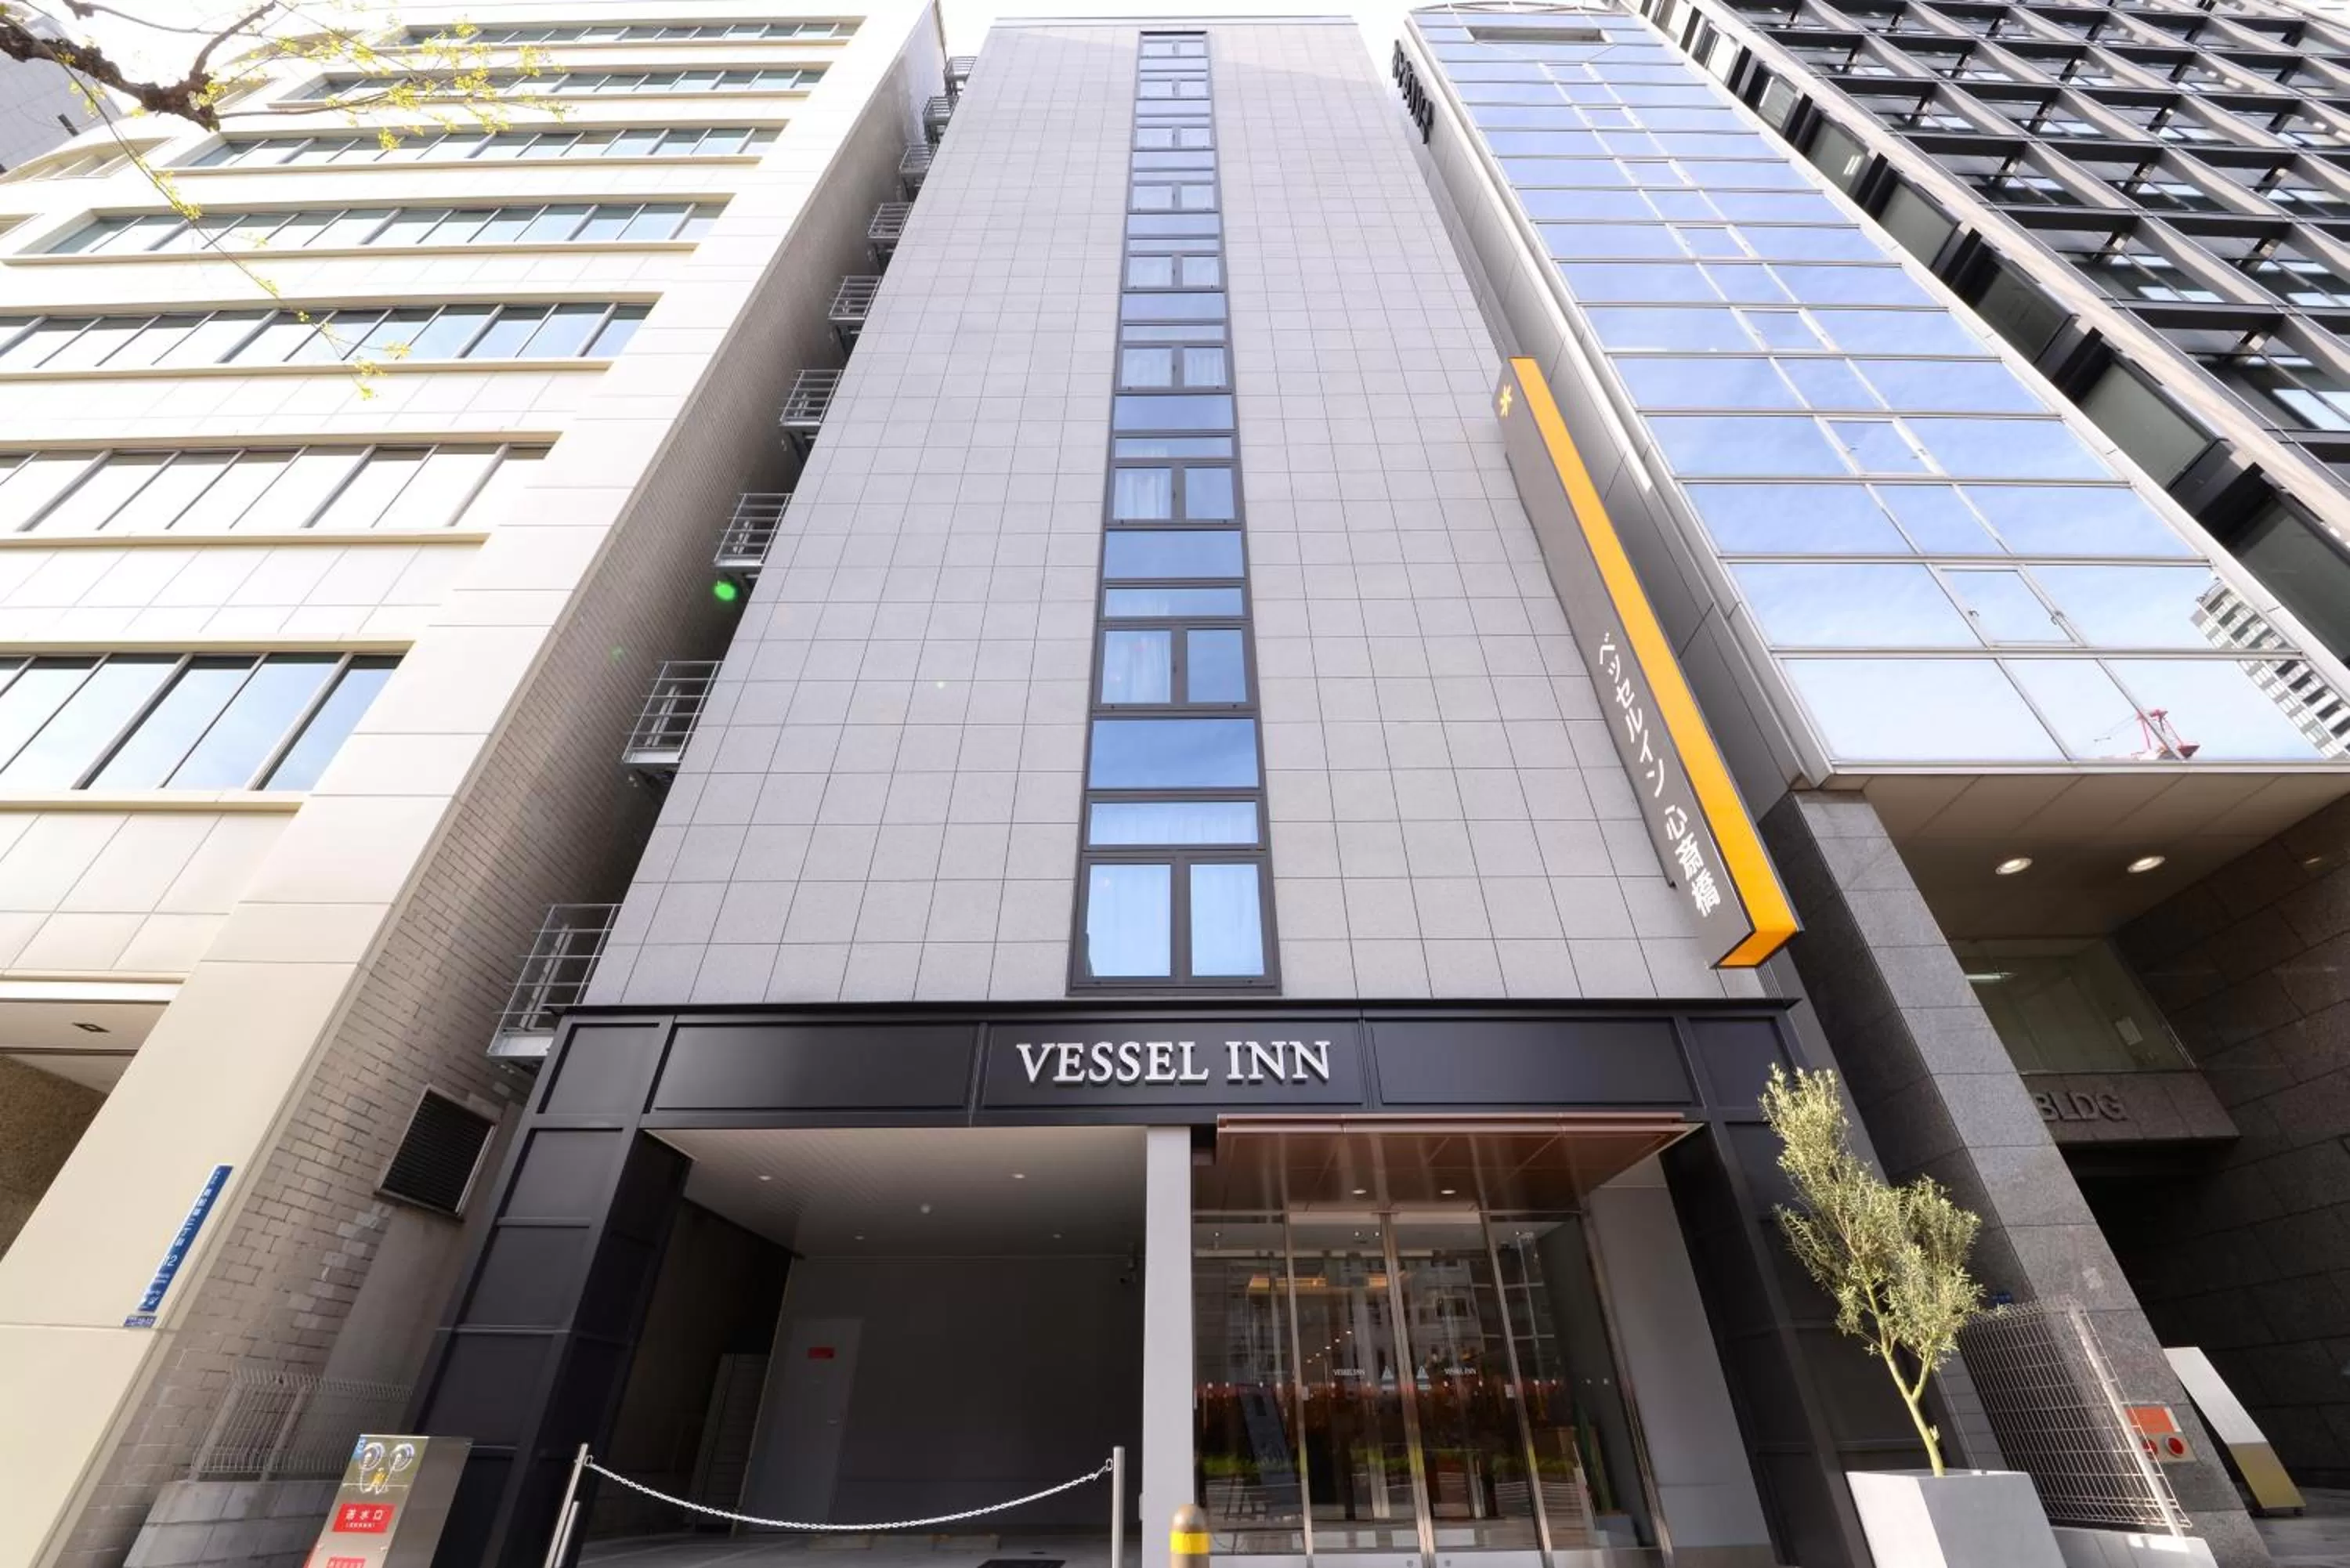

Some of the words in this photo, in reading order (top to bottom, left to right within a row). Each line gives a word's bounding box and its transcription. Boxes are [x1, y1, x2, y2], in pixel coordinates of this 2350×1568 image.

[1598, 631, 1666, 798] ベッセルイン
[1664, 804, 1721, 917] 心斎橋
[1016, 1041, 1209, 1085] VESSEL
[1224, 1040, 1331, 1084] INN
[2031, 1091, 2128, 1122] BLDG
